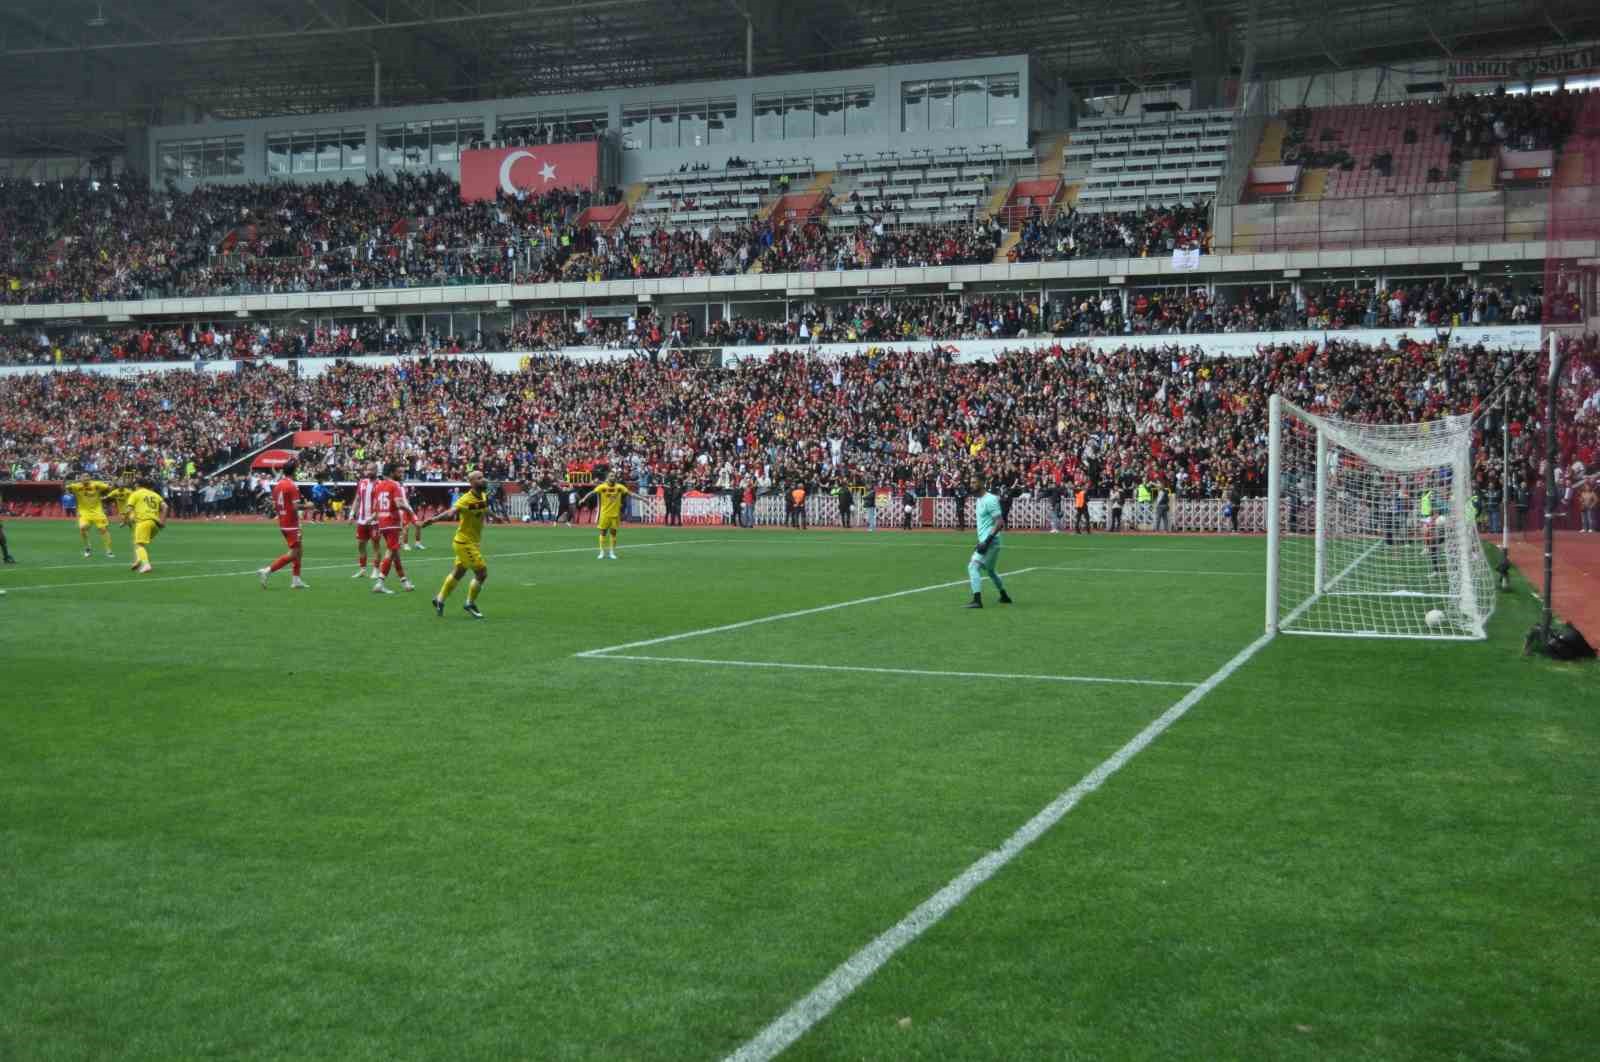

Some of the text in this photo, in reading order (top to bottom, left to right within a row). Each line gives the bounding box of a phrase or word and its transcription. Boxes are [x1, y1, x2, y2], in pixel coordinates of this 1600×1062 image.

[144, 495, 157, 510] 15
[277, 491, 286, 511] 4
[378, 491, 391, 510] 15
